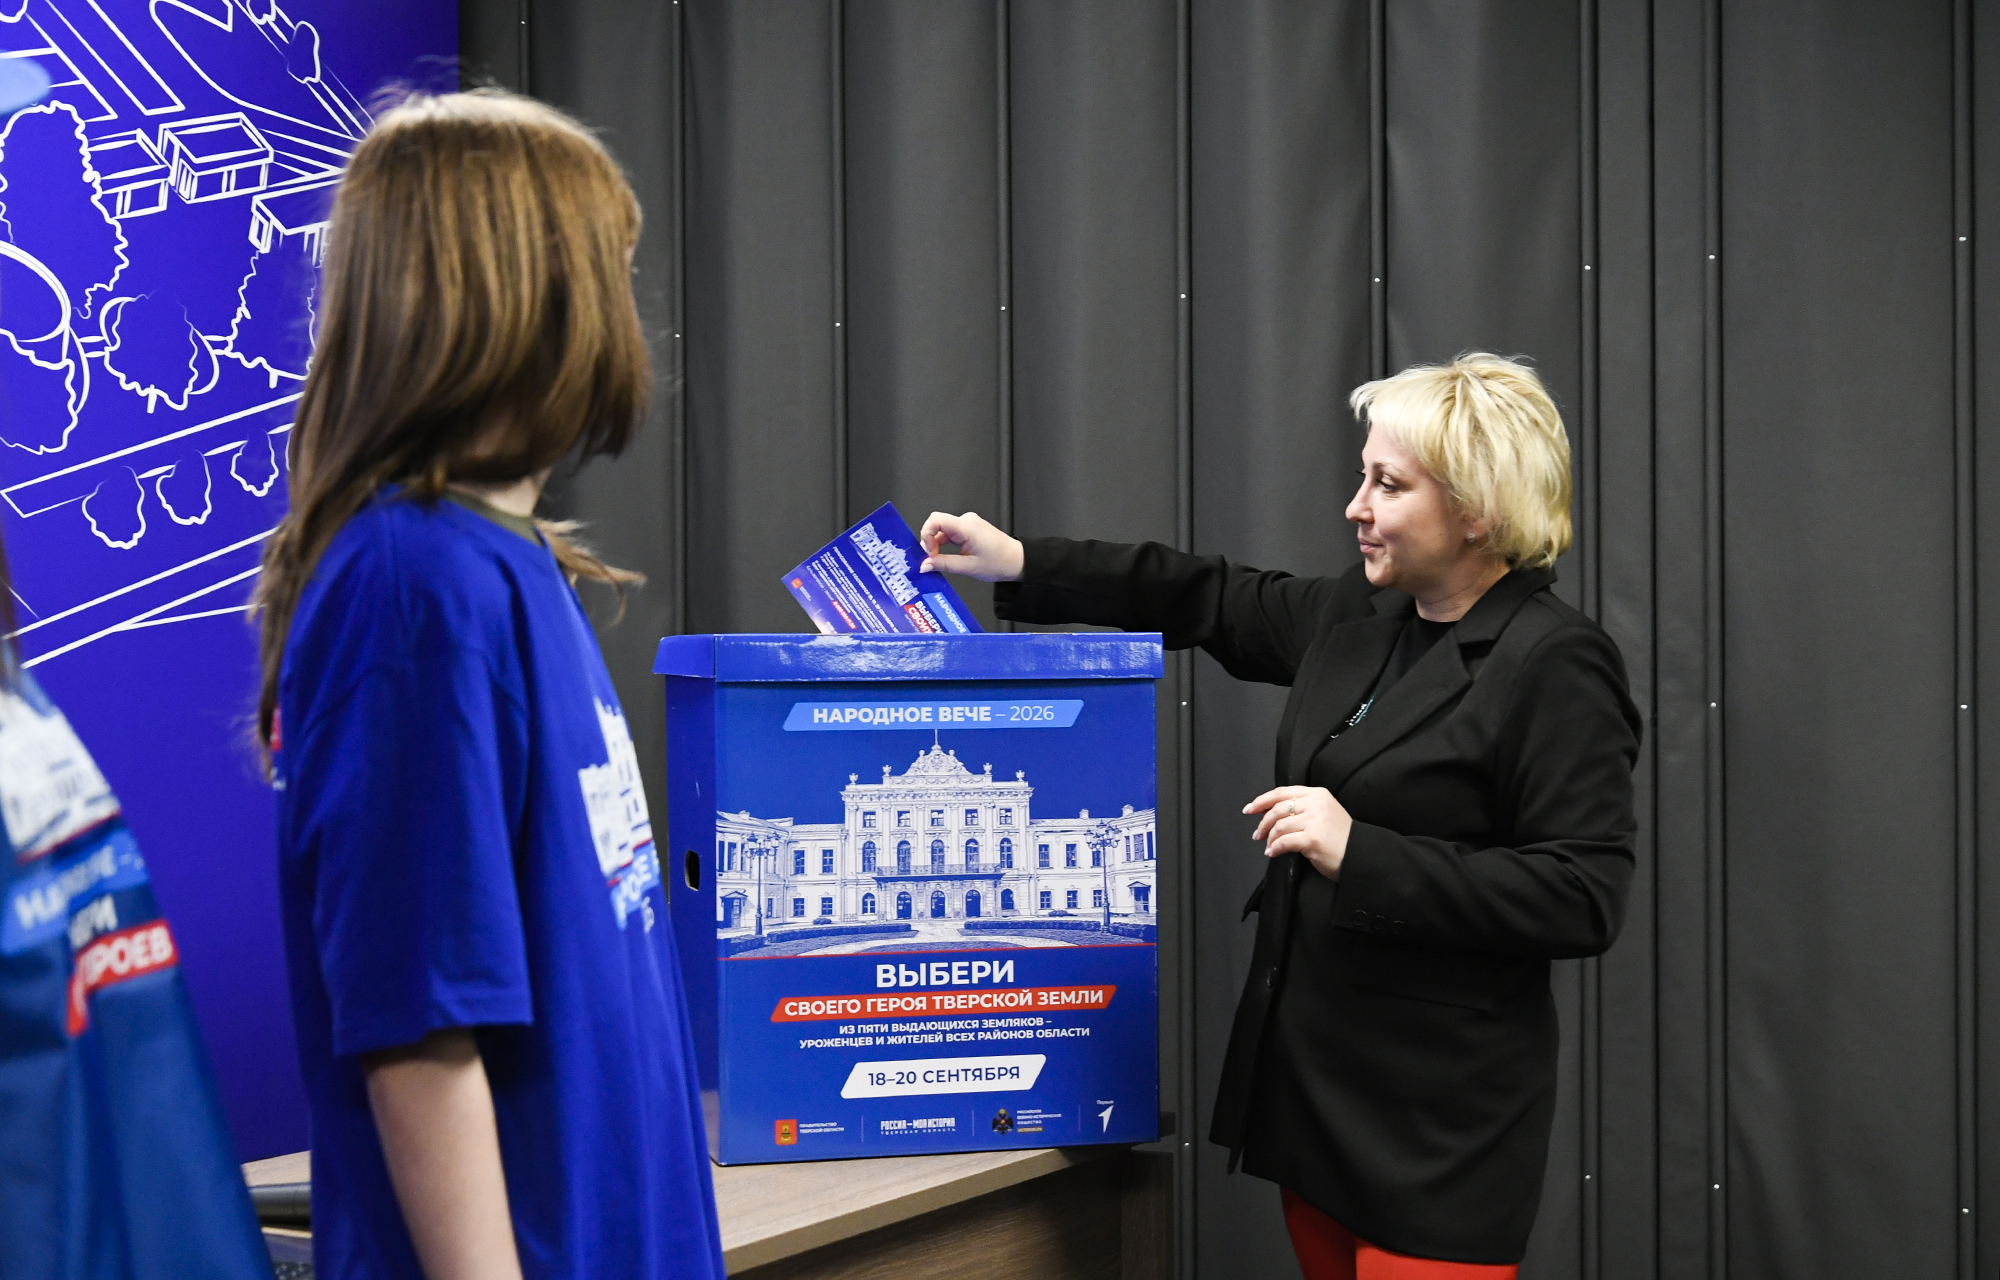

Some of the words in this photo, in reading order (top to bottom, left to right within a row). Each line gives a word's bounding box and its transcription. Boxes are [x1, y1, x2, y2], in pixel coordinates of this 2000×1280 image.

[932, 592, 967, 634] НАРОДНОЕ
[813, 706, 933, 725] НАРОДНОЕ
[938, 706, 991, 722] ВЕЧЕ
[1009, 705, 1055, 721] 2026
[876, 960, 1015, 988] ВЫБЕРИ
[784, 999, 861, 1017] СВОЕГО
[866, 996, 927, 1013] ГЕРОЯ
[931, 988, 1033, 1010] ТВЕРСКОЙ
[1037, 989, 1104, 1006] ЗЕМЛИ
[839, 1025, 855, 1035] ИЗ
[857, 1023, 889, 1034] ПЯТИ
[891, 1019, 980, 1033] ВЫДАЮЩИХСЯ
[981, 1017, 1044, 1029] ЗЕМЛЯКОВ
[799, 1036, 873, 1049] УРОЖЕНЦЕВ
[875, 1035, 885, 1045] И
[886, 1031, 943, 1045] ЖИТЕЛЕЙ
[945, 1032, 976, 1042] ВСЕХ
[977, 1027, 1034, 1041] РАЙОНОВ
[1035, 1027, 1090, 1038] ОБЛАСТИ
[868, 1071, 917, 1086] 18–20
[922, 1066, 1020, 1083] СЕНТЯБРЯ
